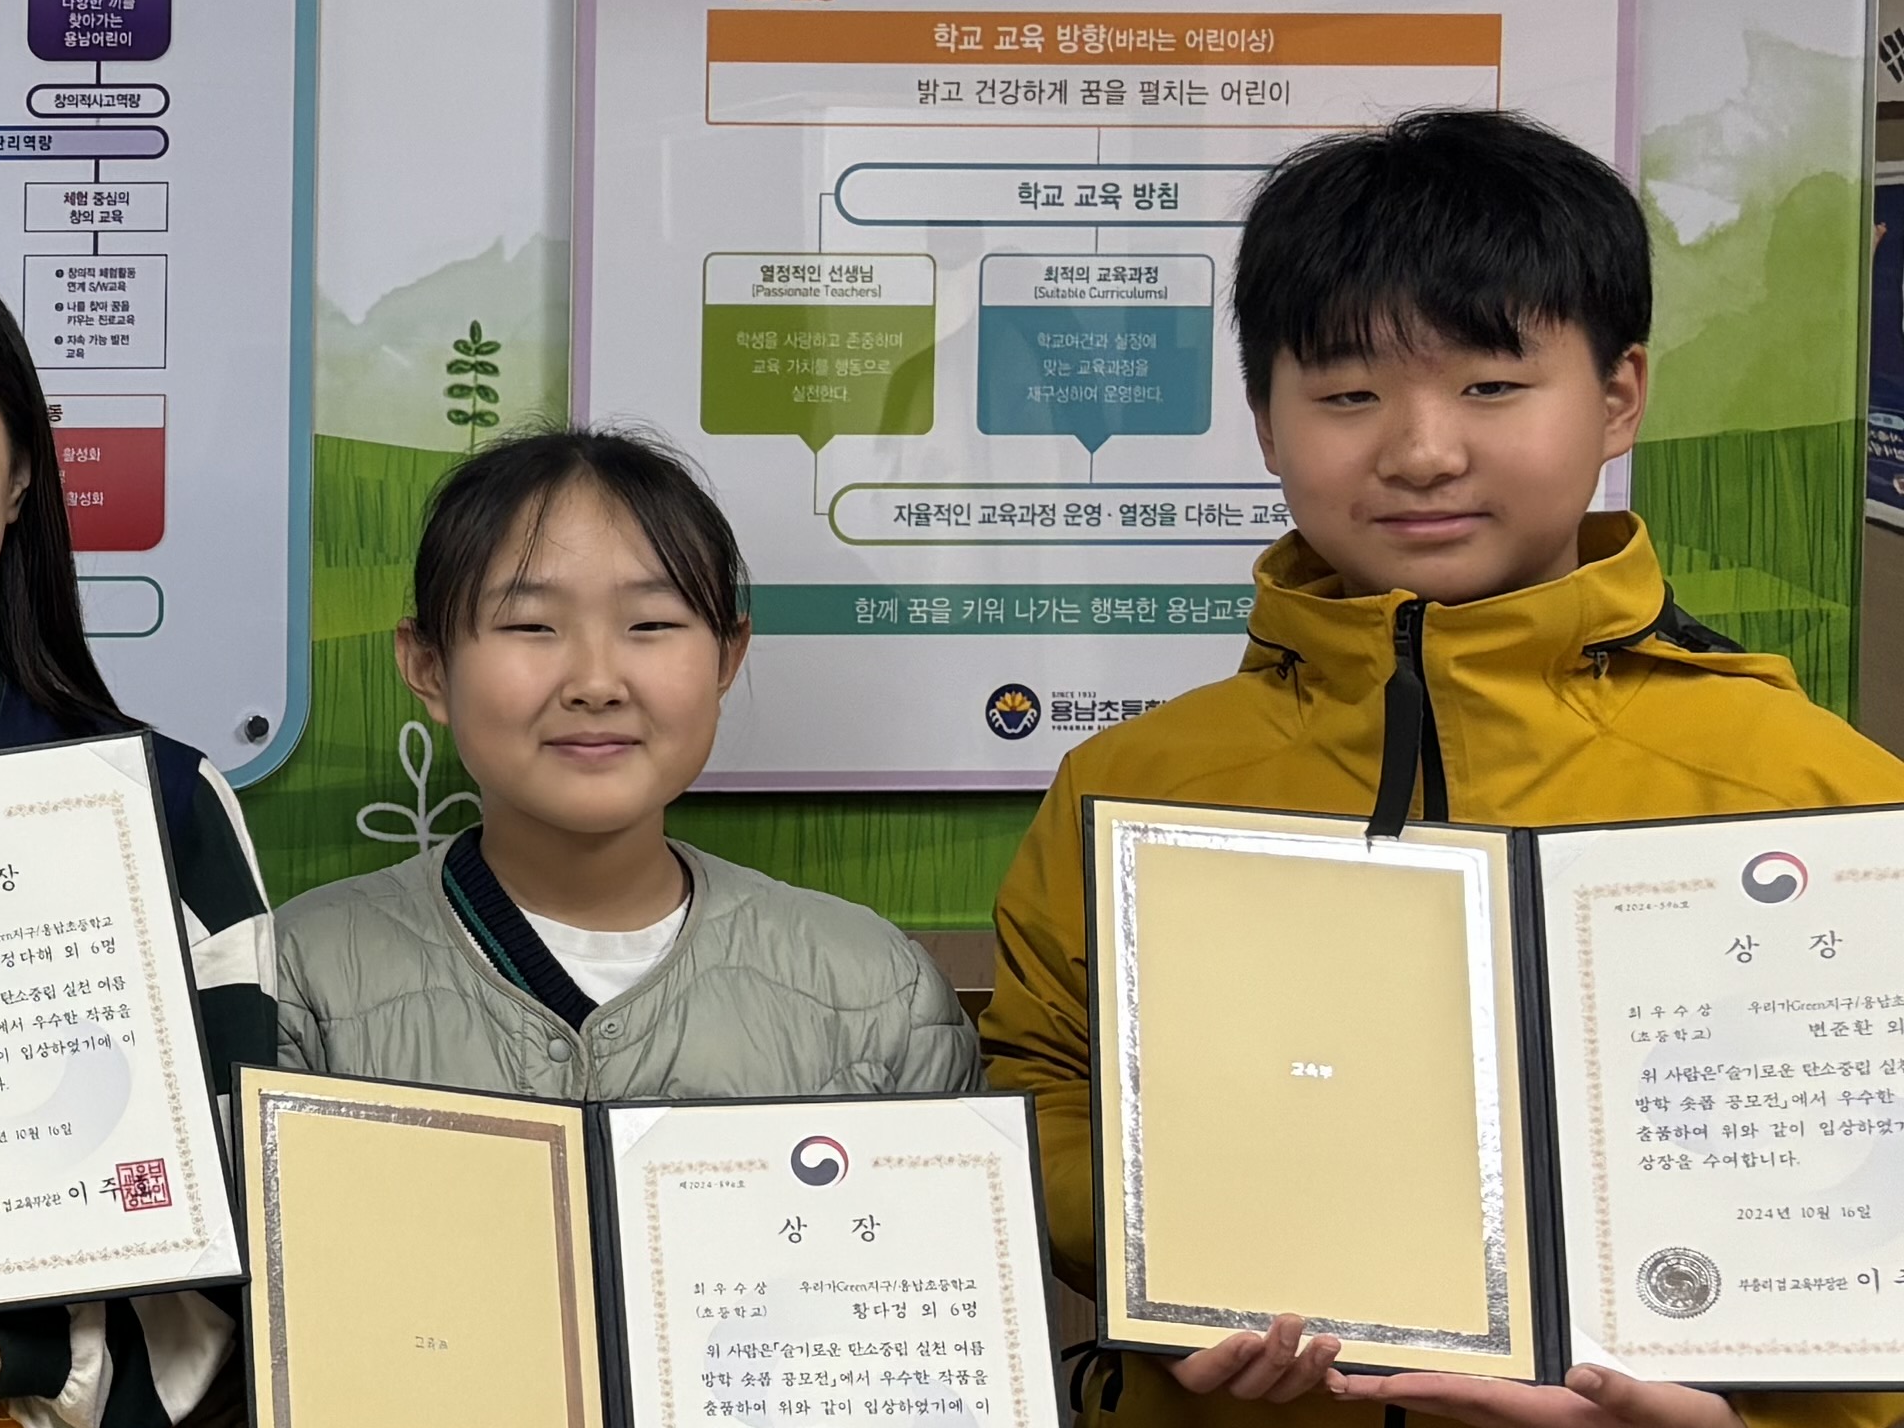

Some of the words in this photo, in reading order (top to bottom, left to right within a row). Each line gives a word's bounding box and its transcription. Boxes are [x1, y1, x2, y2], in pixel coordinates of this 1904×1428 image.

[933, 23, 984, 53] 학교
[994, 24, 1045, 53] 교육
[1057, 24, 1176, 54] 방향(바라는
[1185, 28, 1274, 52] 어린이상)
[54, 94, 141, 108] 창의적사고역량
[1018, 182, 1064, 210] 학교
[1074, 183, 1122, 210] 교육
[1133, 182, 1178, 210] 방침
[760, 264, 821, 283] 열정적인
[828, 265, 873, 283] 선생님
[1044, 266, 1090, 284] 최적의
[1096, 266, 1158, 284] 교육과정
[855, 598, 898, 623] 함께
[907, 597, 952, 624] 꿈을
[962, 598, 1004, 623] 키워
[1015, 597, 1081, 623] 나가는
[1091, 597, 1158, 623] 행복한
